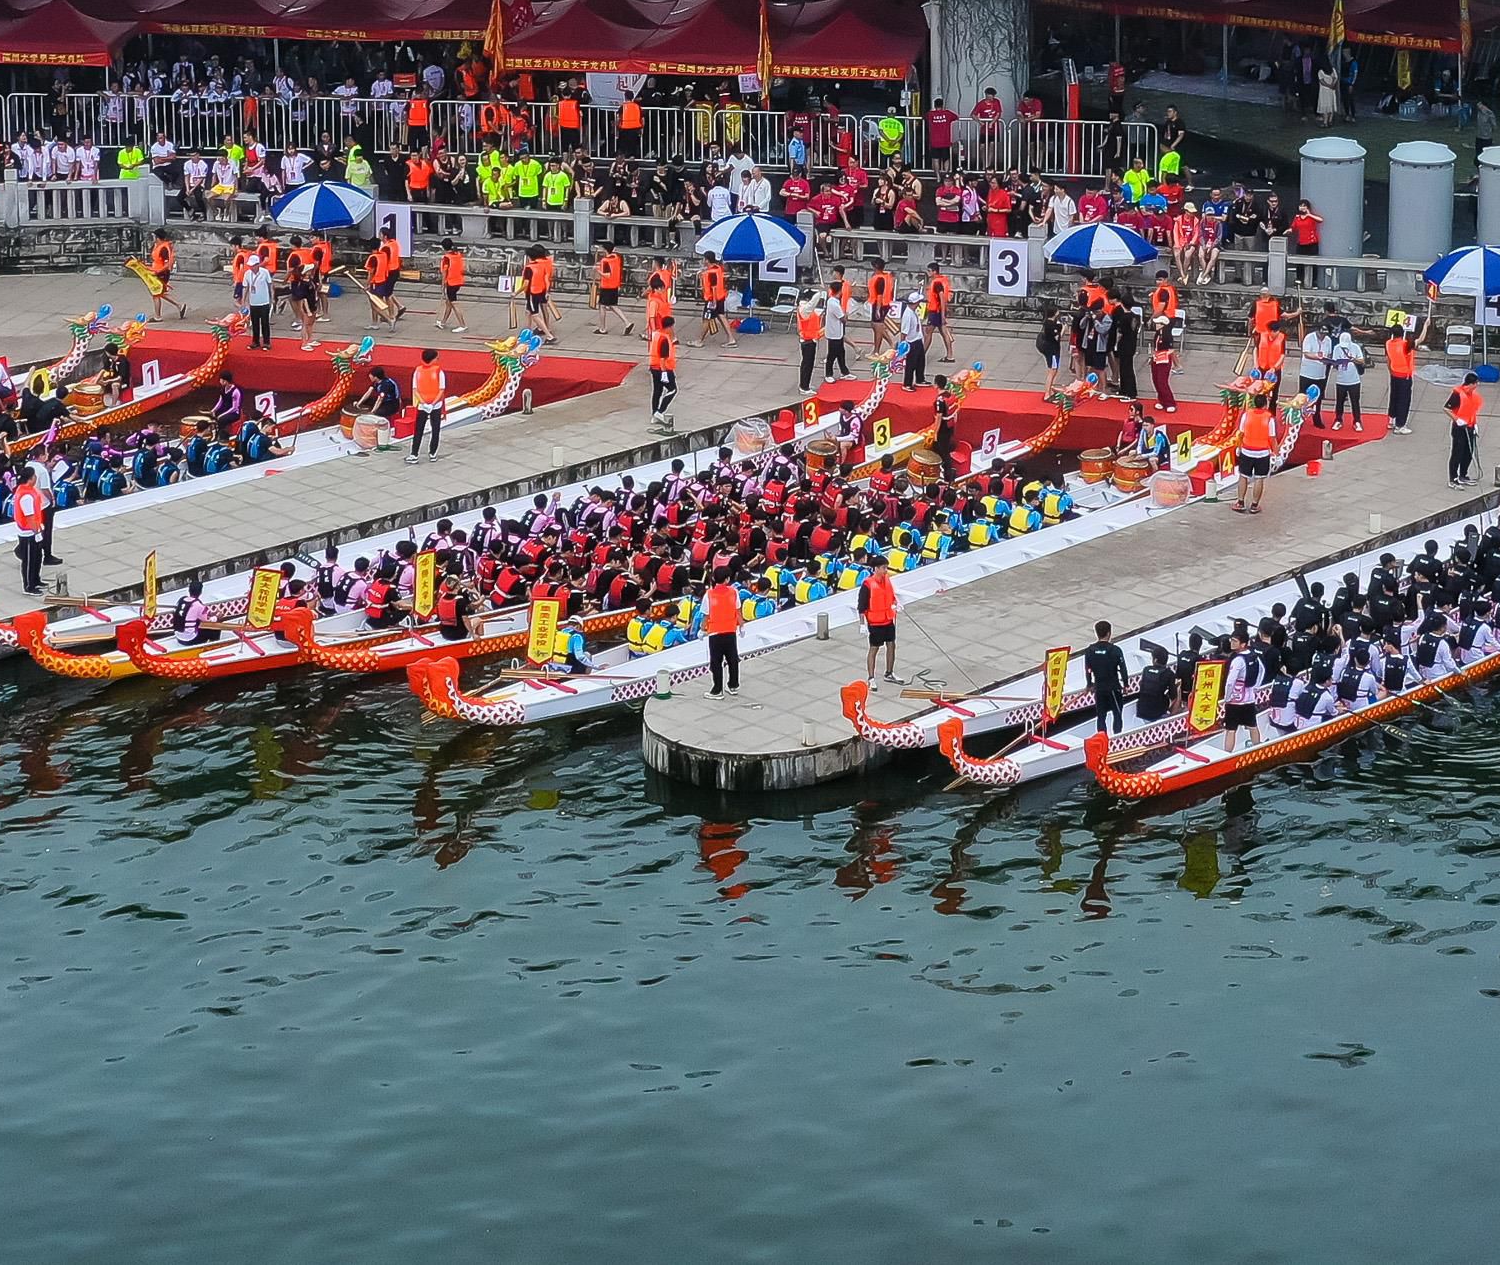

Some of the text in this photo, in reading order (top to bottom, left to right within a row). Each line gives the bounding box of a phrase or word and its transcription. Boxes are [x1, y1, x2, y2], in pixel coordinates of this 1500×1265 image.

[766, 258, 788, 273] 2
[996, 249, 1020, 287] 3
[146, 365, 154, 386] 1
[259, 397, 272, 418] 2
[805, 402, 817, 425] 3
[876, 424, 888, 446] 3
[984, 434, 996, 455] 3
[1179, 436, 1189, 458] 4
[1222, 451, 1233, 474] 4
[1199, 669, 1215, 713] 福州大学
